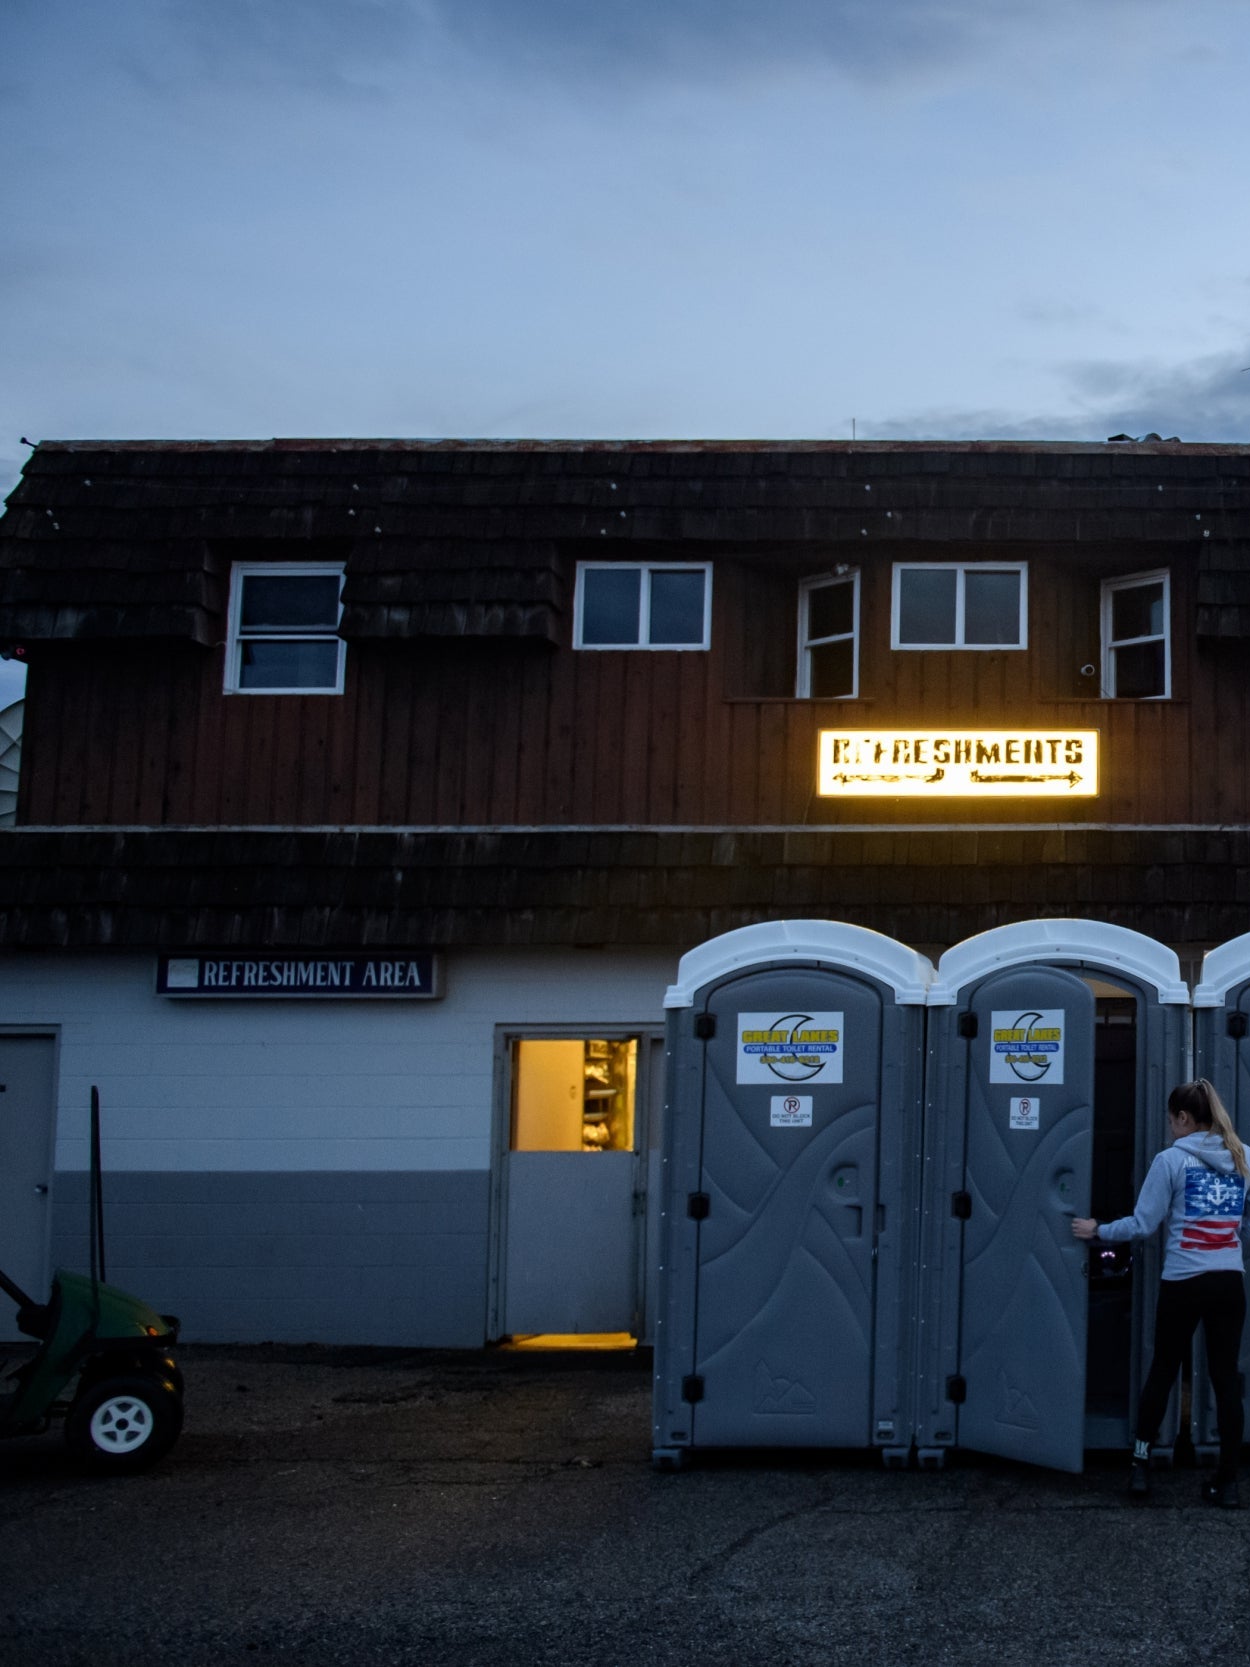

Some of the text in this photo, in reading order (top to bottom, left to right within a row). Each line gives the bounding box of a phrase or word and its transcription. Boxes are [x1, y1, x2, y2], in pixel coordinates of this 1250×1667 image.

[833, 739, 1083, 764] RFRESHMENTS
[203, 961, 422, 987] REFRESHMENT AREA
[742, 1030, 839, 1043] GREAT LAKES
[746, 1045, 780, 1053] PORTABLE
